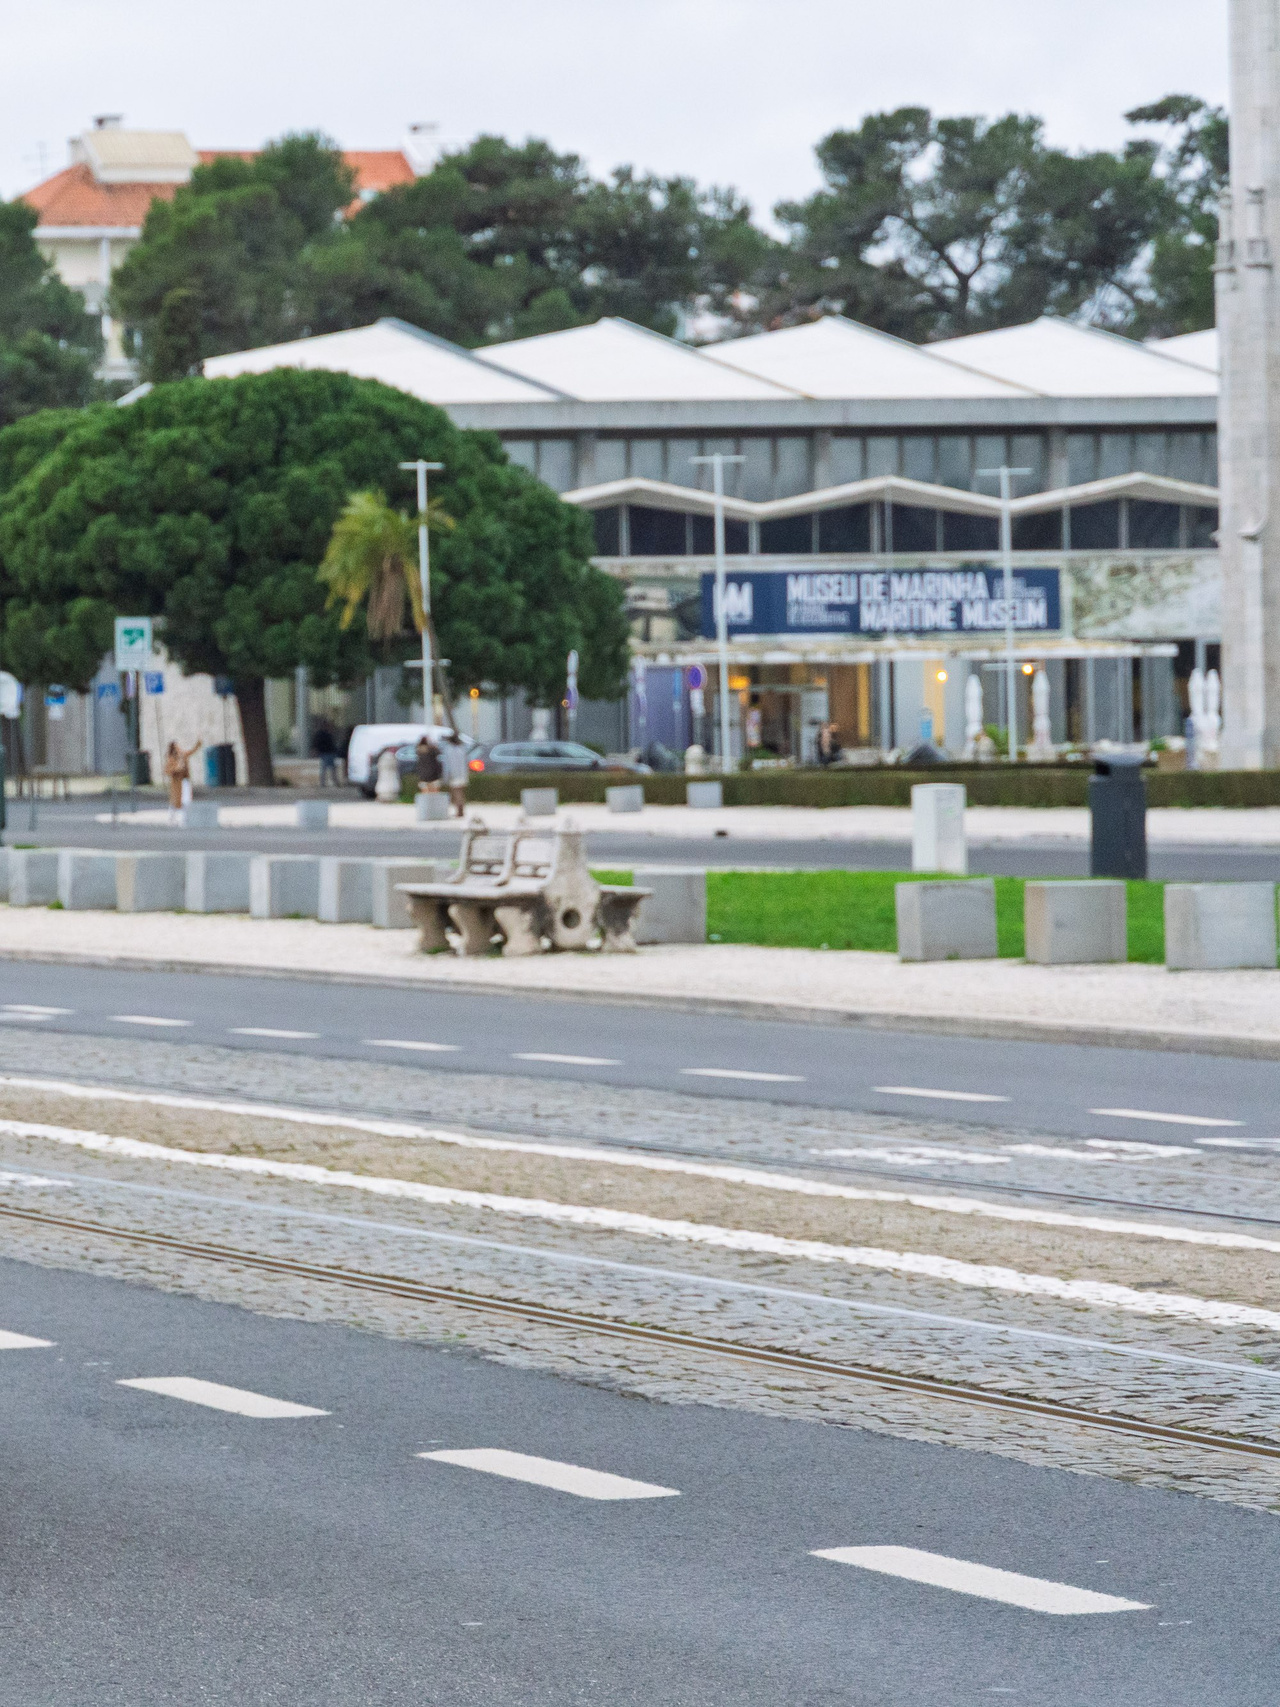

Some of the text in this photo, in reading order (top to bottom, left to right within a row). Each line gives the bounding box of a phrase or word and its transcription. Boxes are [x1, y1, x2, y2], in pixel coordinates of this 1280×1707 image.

[786, 574, 858, 603] MUSEU
[859, 573, 888, 600] DE
[890, 572, 990, 600] MARINHA
[860, 601, 958, 630] MARITIME
[962, 599, 1047, 628] MUSEUM
